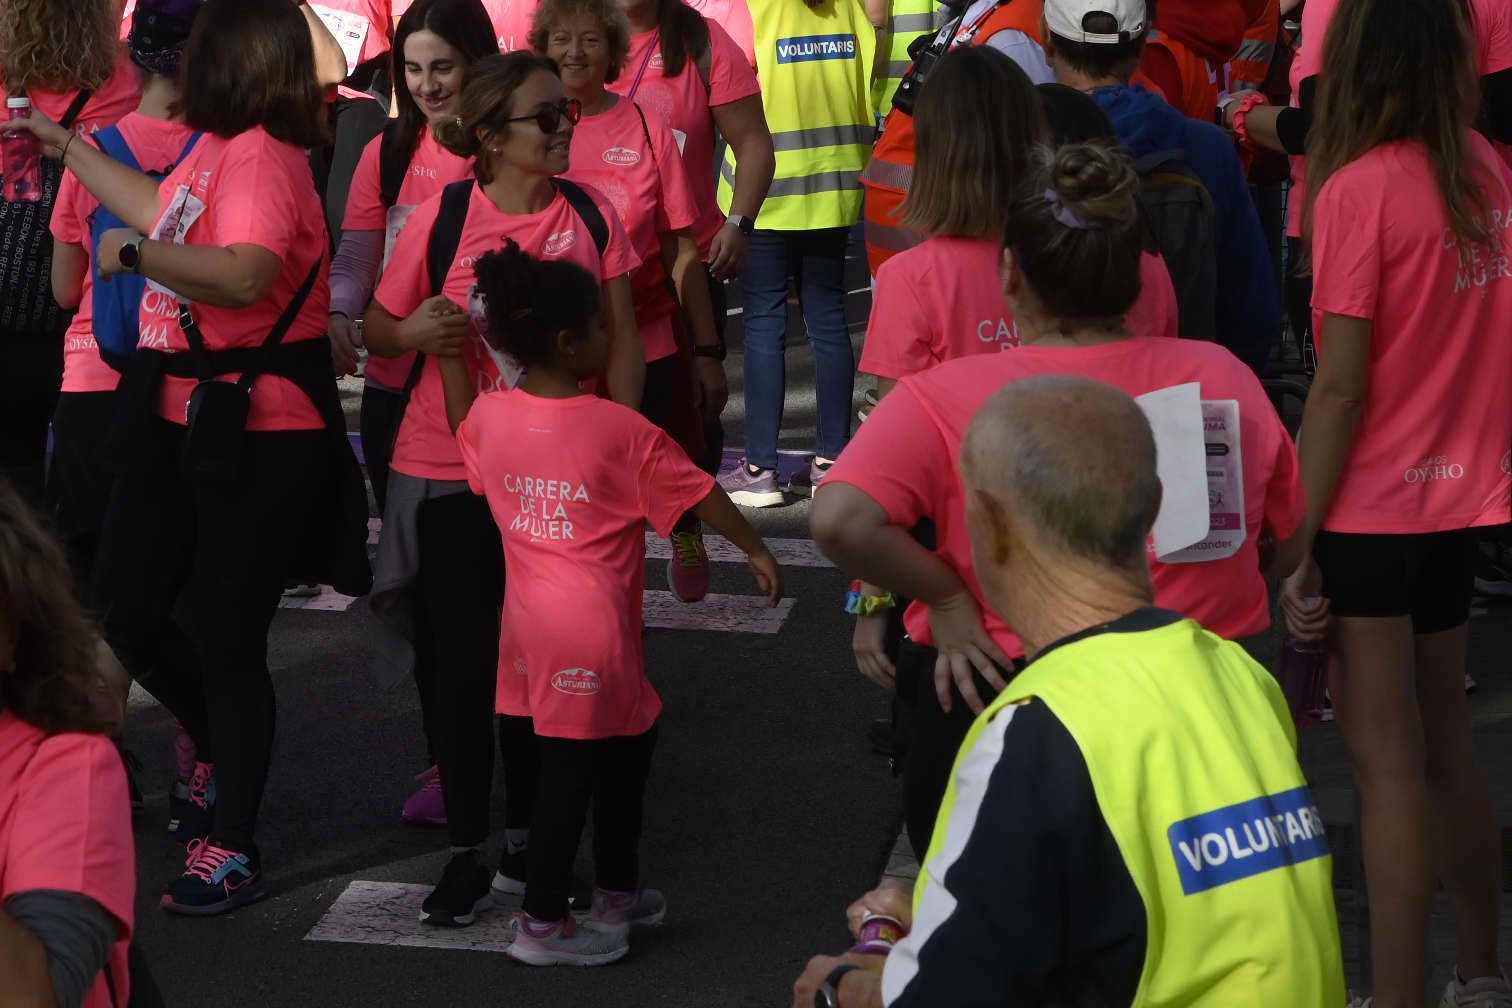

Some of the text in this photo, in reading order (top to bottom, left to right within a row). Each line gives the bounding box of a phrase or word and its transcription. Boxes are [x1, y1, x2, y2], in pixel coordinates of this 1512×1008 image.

[779, 41, 854, 58] VOLUNTARIS
[70, 336, 97, 349] OYSH
[1404, 464, 1464, 484] OYSHO
[504, 473, 590, 503] CARRERA
[520, 495, 568, 521] DE LA
[510, 514, 575, 541] MUJER
